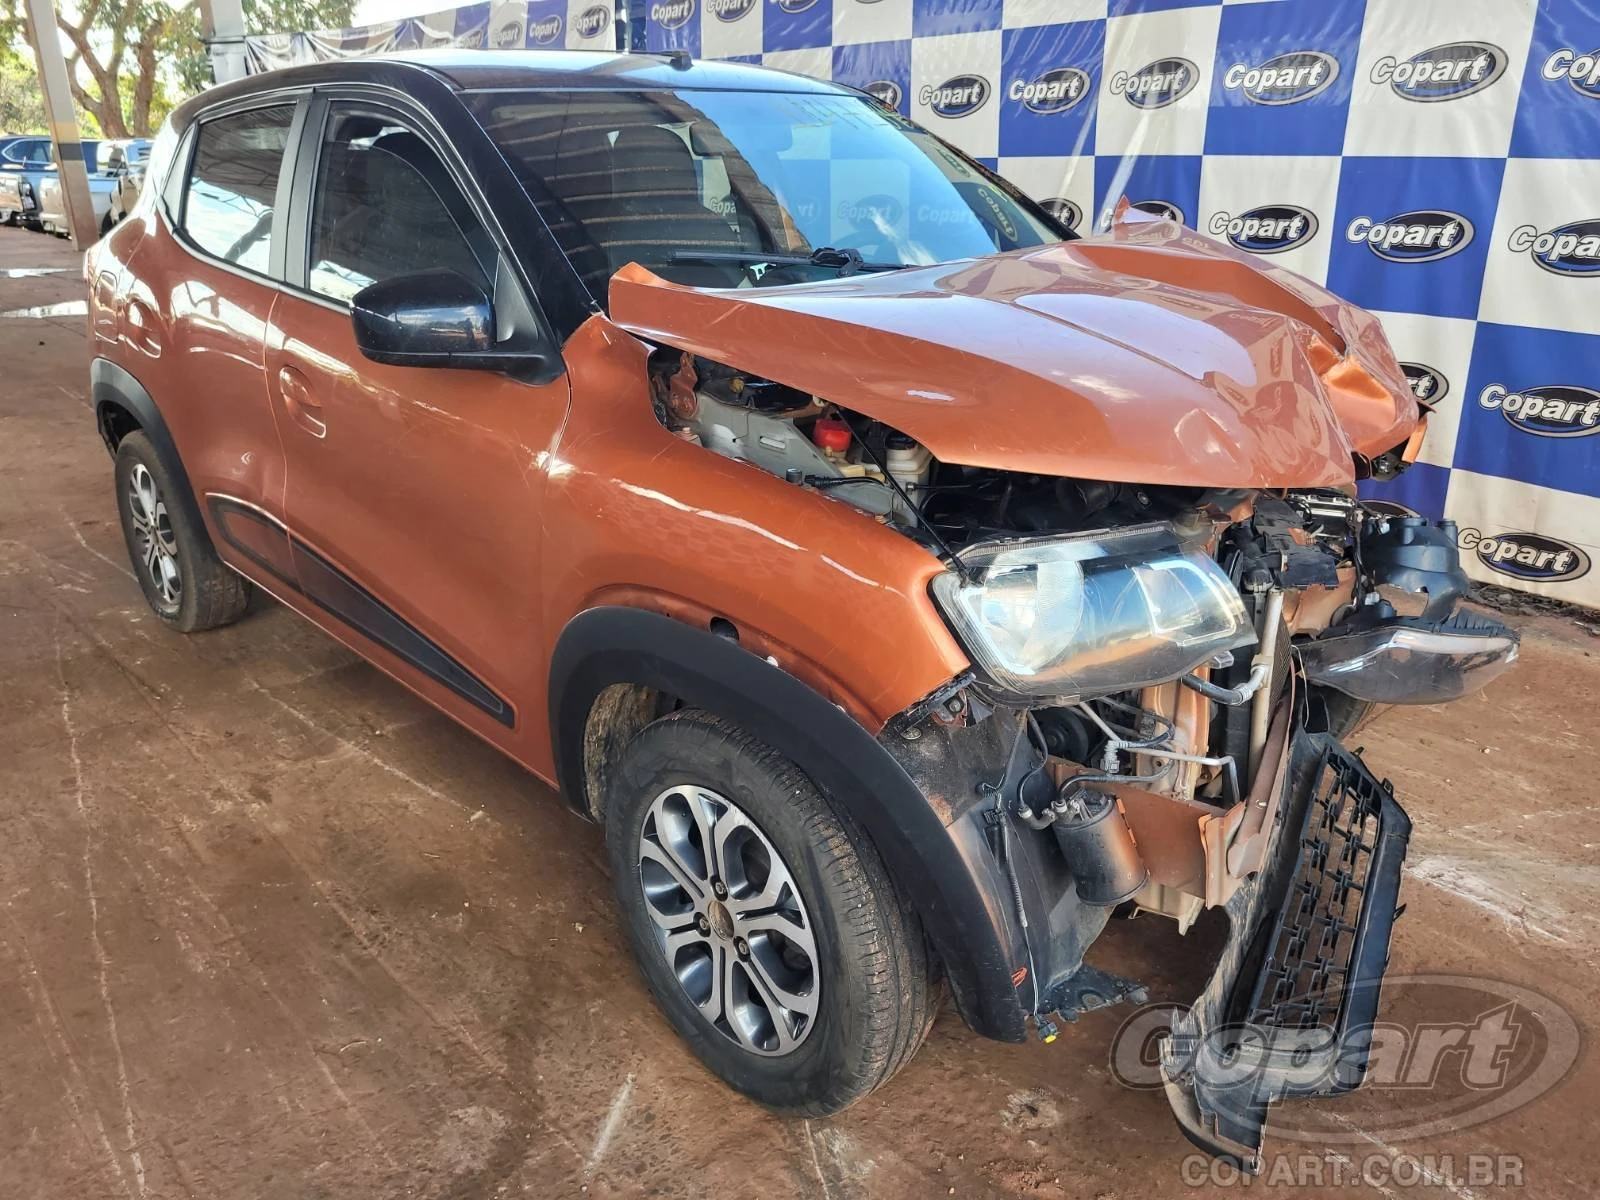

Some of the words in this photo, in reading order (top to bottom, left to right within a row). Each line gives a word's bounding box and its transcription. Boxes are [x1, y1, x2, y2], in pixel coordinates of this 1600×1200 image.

[651, 1, 689, 22] Copart
[529, 19, 559, 39] Copart
[1109, 65, 1186, 99] Copart
[1223, 59, 1326, 95] Copart
[1370, 51, 1490, 89] Copart
[919, 81, 982, 110] Copart
[1008, 75, 1081, 105] Copart
[710, 197, 737, 216] Copa
[1208, 211, 1304, 241] Copart
[1346, 216, 1460, 249] Copart
[1508, 224, 1600, 262] Copa
[1479, 383, 1600, 426] Copart
[1457, 527, 1573, 573] Copart
